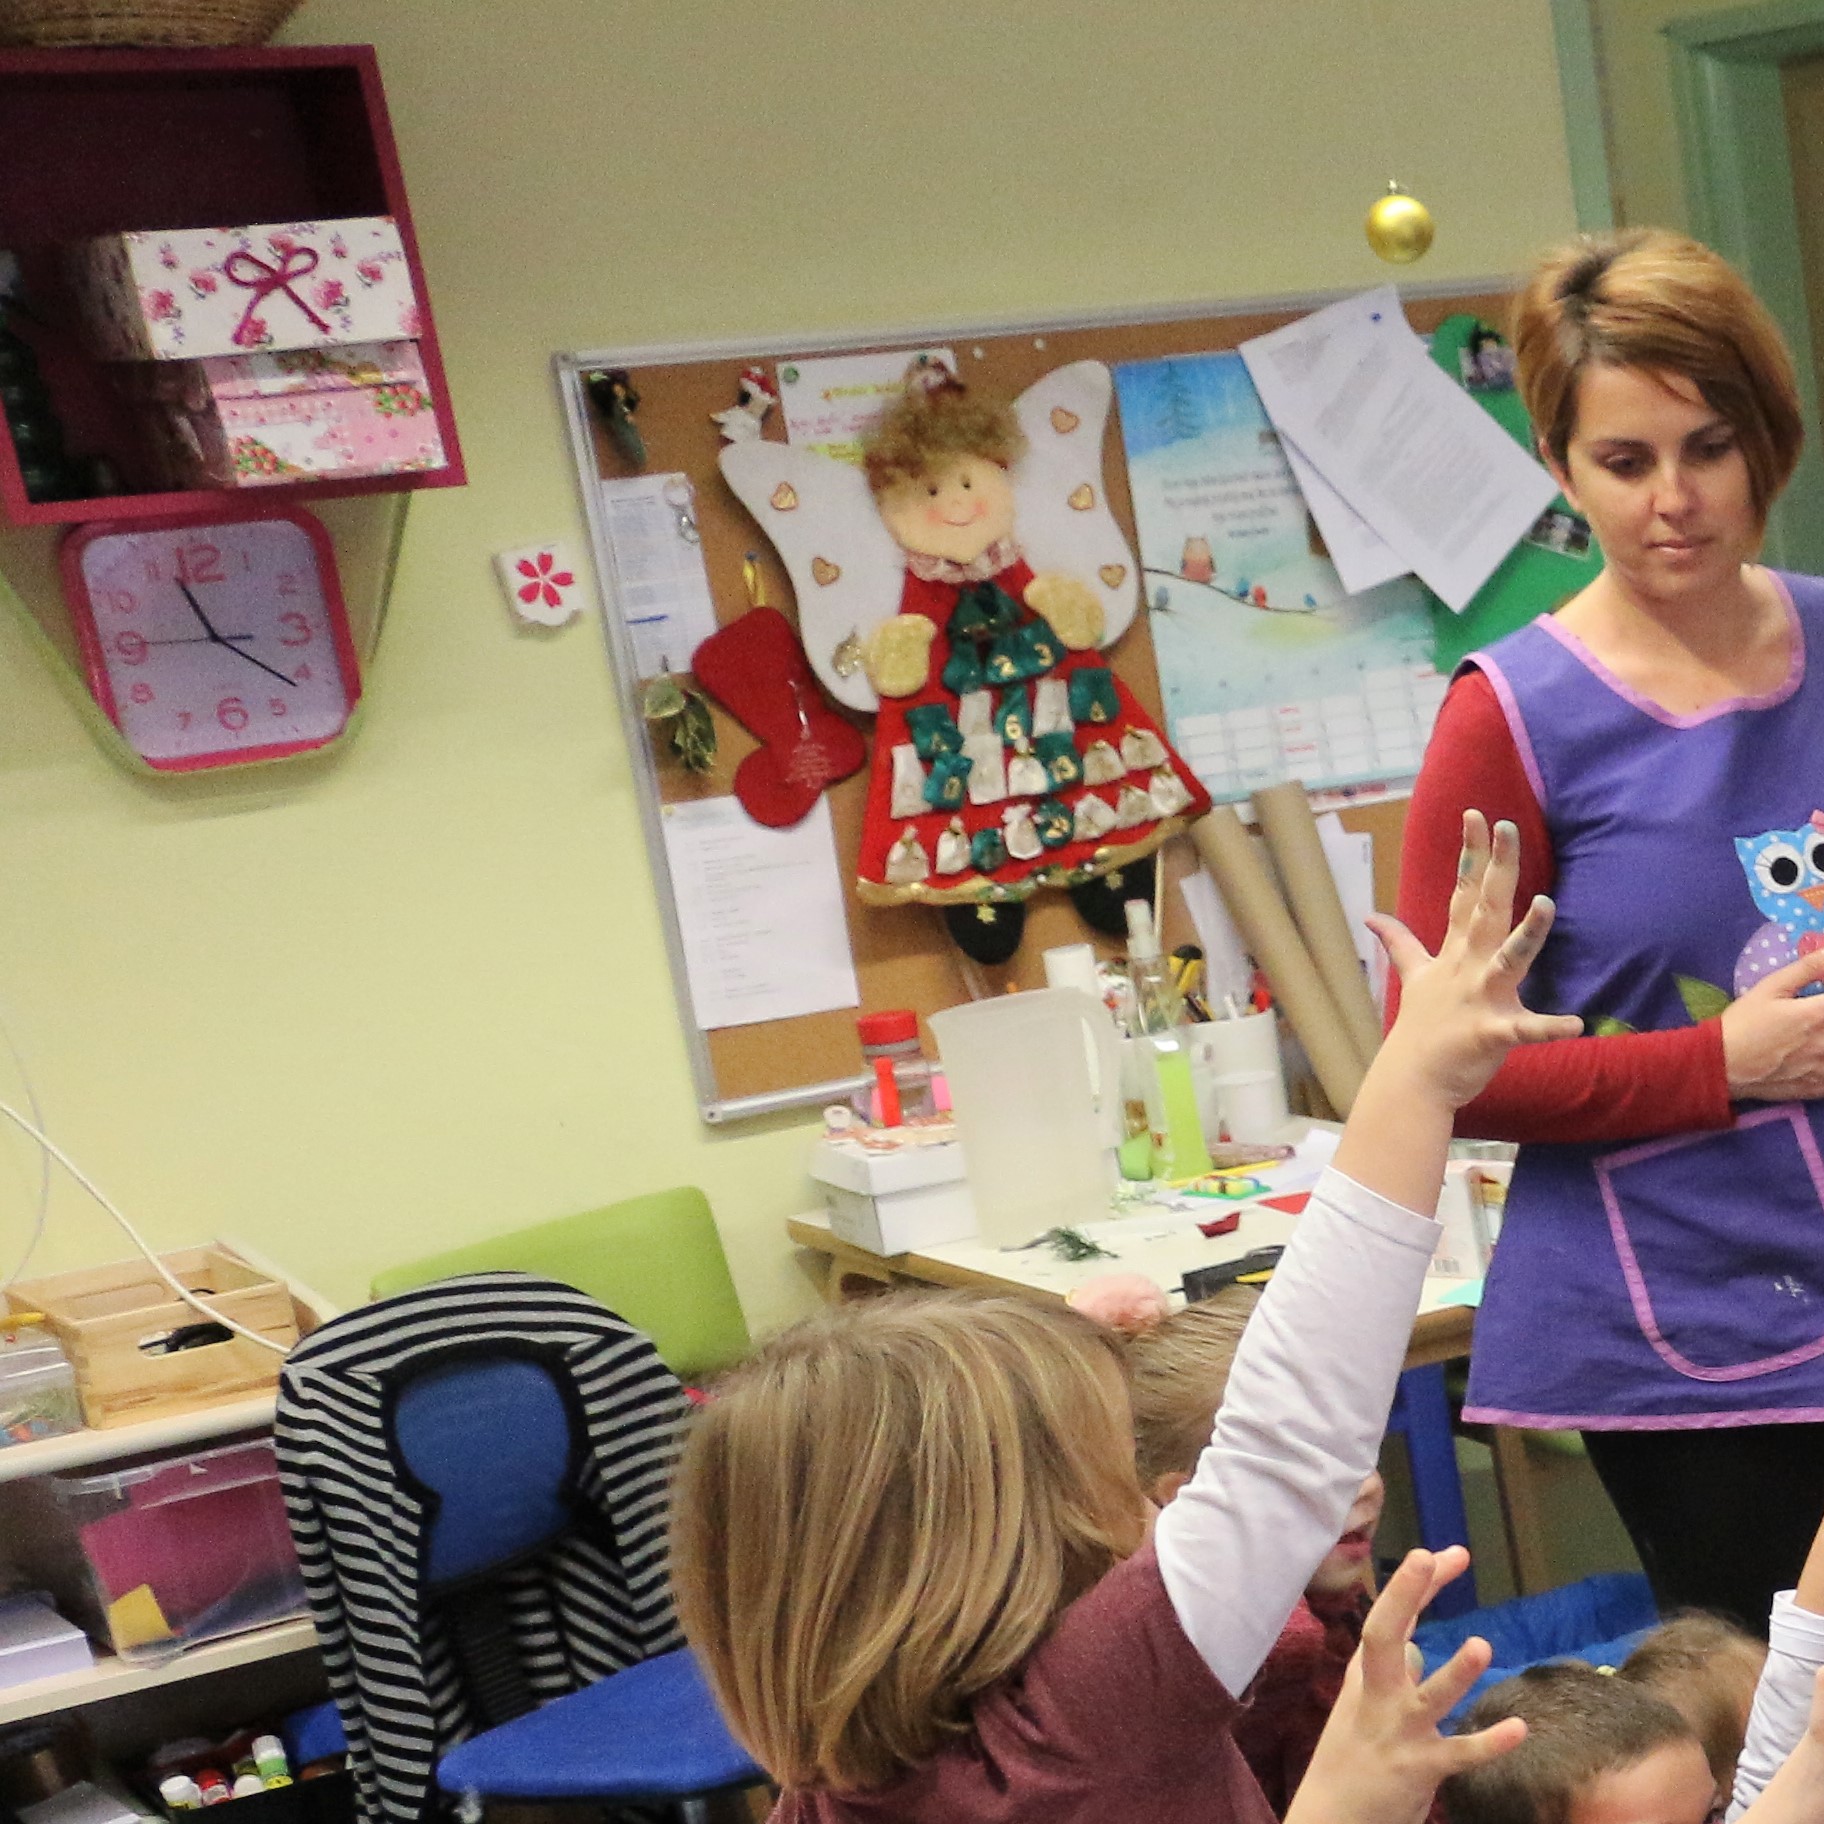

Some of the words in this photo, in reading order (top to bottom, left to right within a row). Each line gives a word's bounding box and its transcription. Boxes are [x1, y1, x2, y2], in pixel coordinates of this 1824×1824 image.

[175, 543, 227, 585] 12
[277, 611, 312, 647] 3
[115, 630, 149, 666] 9
[1034, 643, 1054, 666] 3
[216, 697, 249, 731] 6
[1005, 714, 1023, 740] 6
